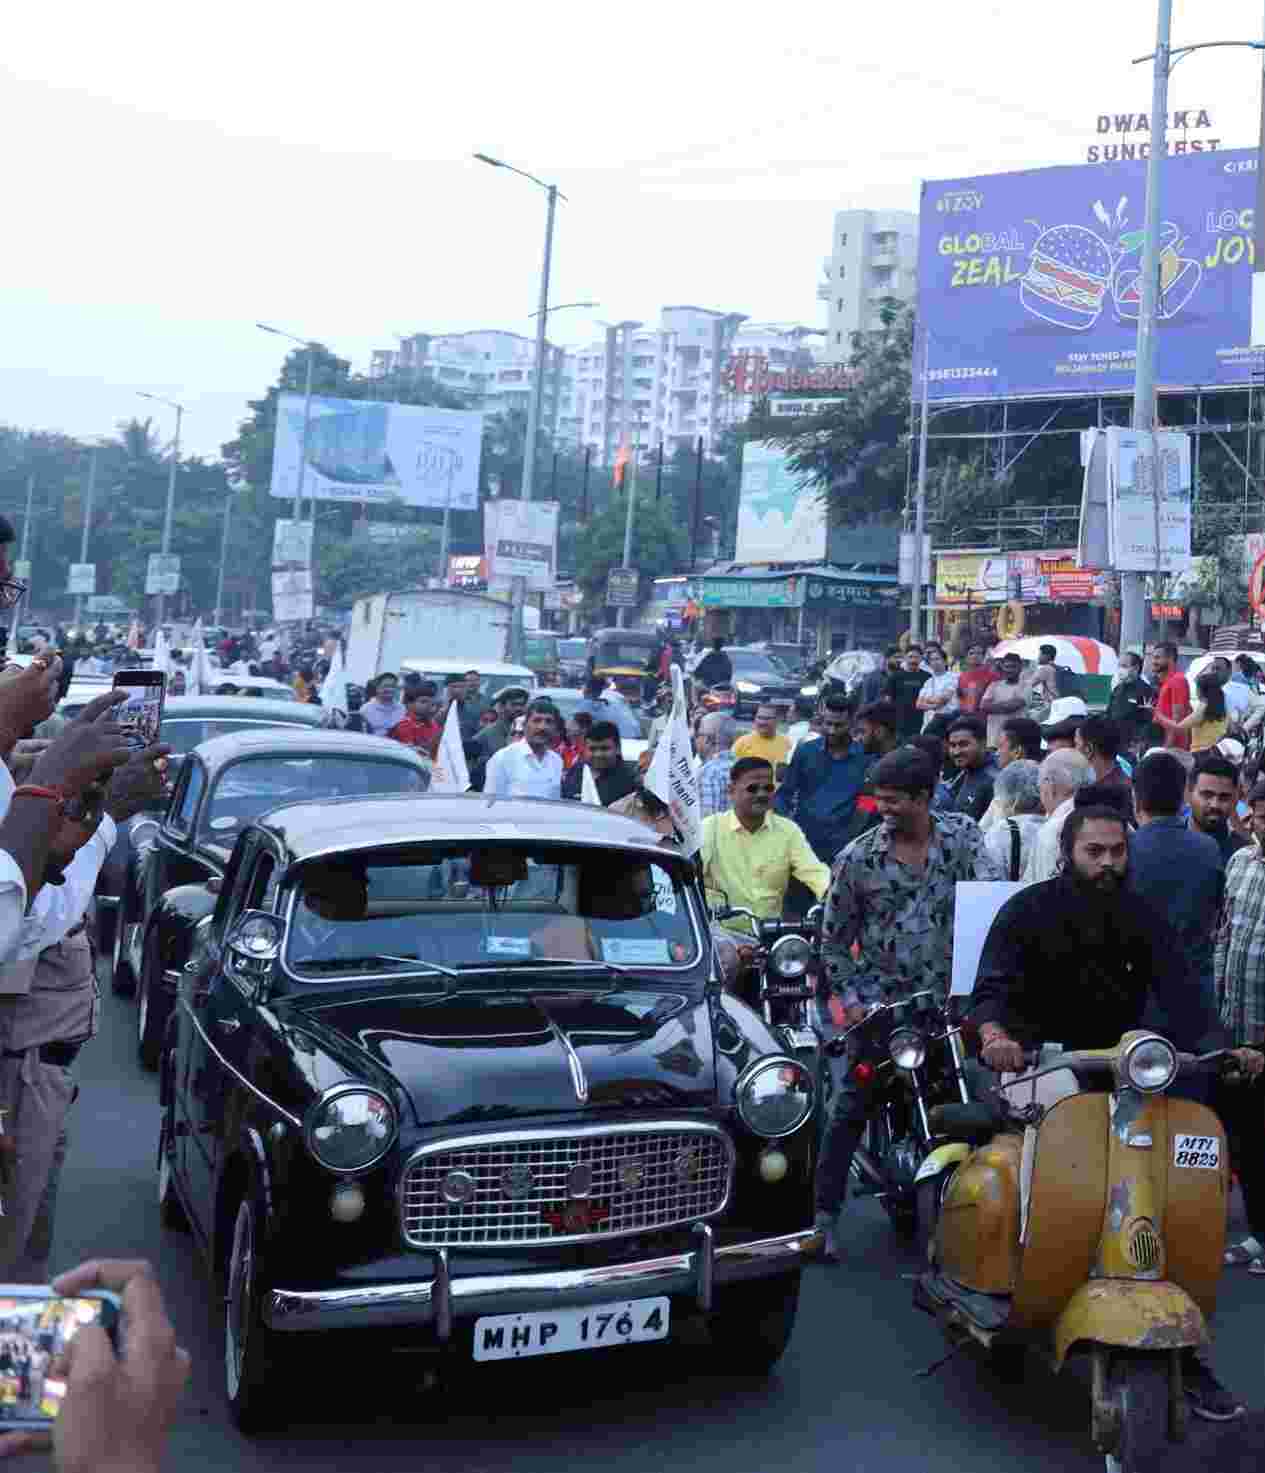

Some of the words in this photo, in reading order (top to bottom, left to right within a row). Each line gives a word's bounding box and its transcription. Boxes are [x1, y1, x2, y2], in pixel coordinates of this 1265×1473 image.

[1097, 109, 1211, 133] DWAKA
[1087, 139, 1220, 162] SUNCEST
[939, 227, 1025, 256] GLOBAL
[952, 255, 1030, 287] ZEAL
[1175, 1151, 1219, 1168] 8829
[483, 1322, 558, 1351] MHP
[580, 1306, 664, 1342] 1764
